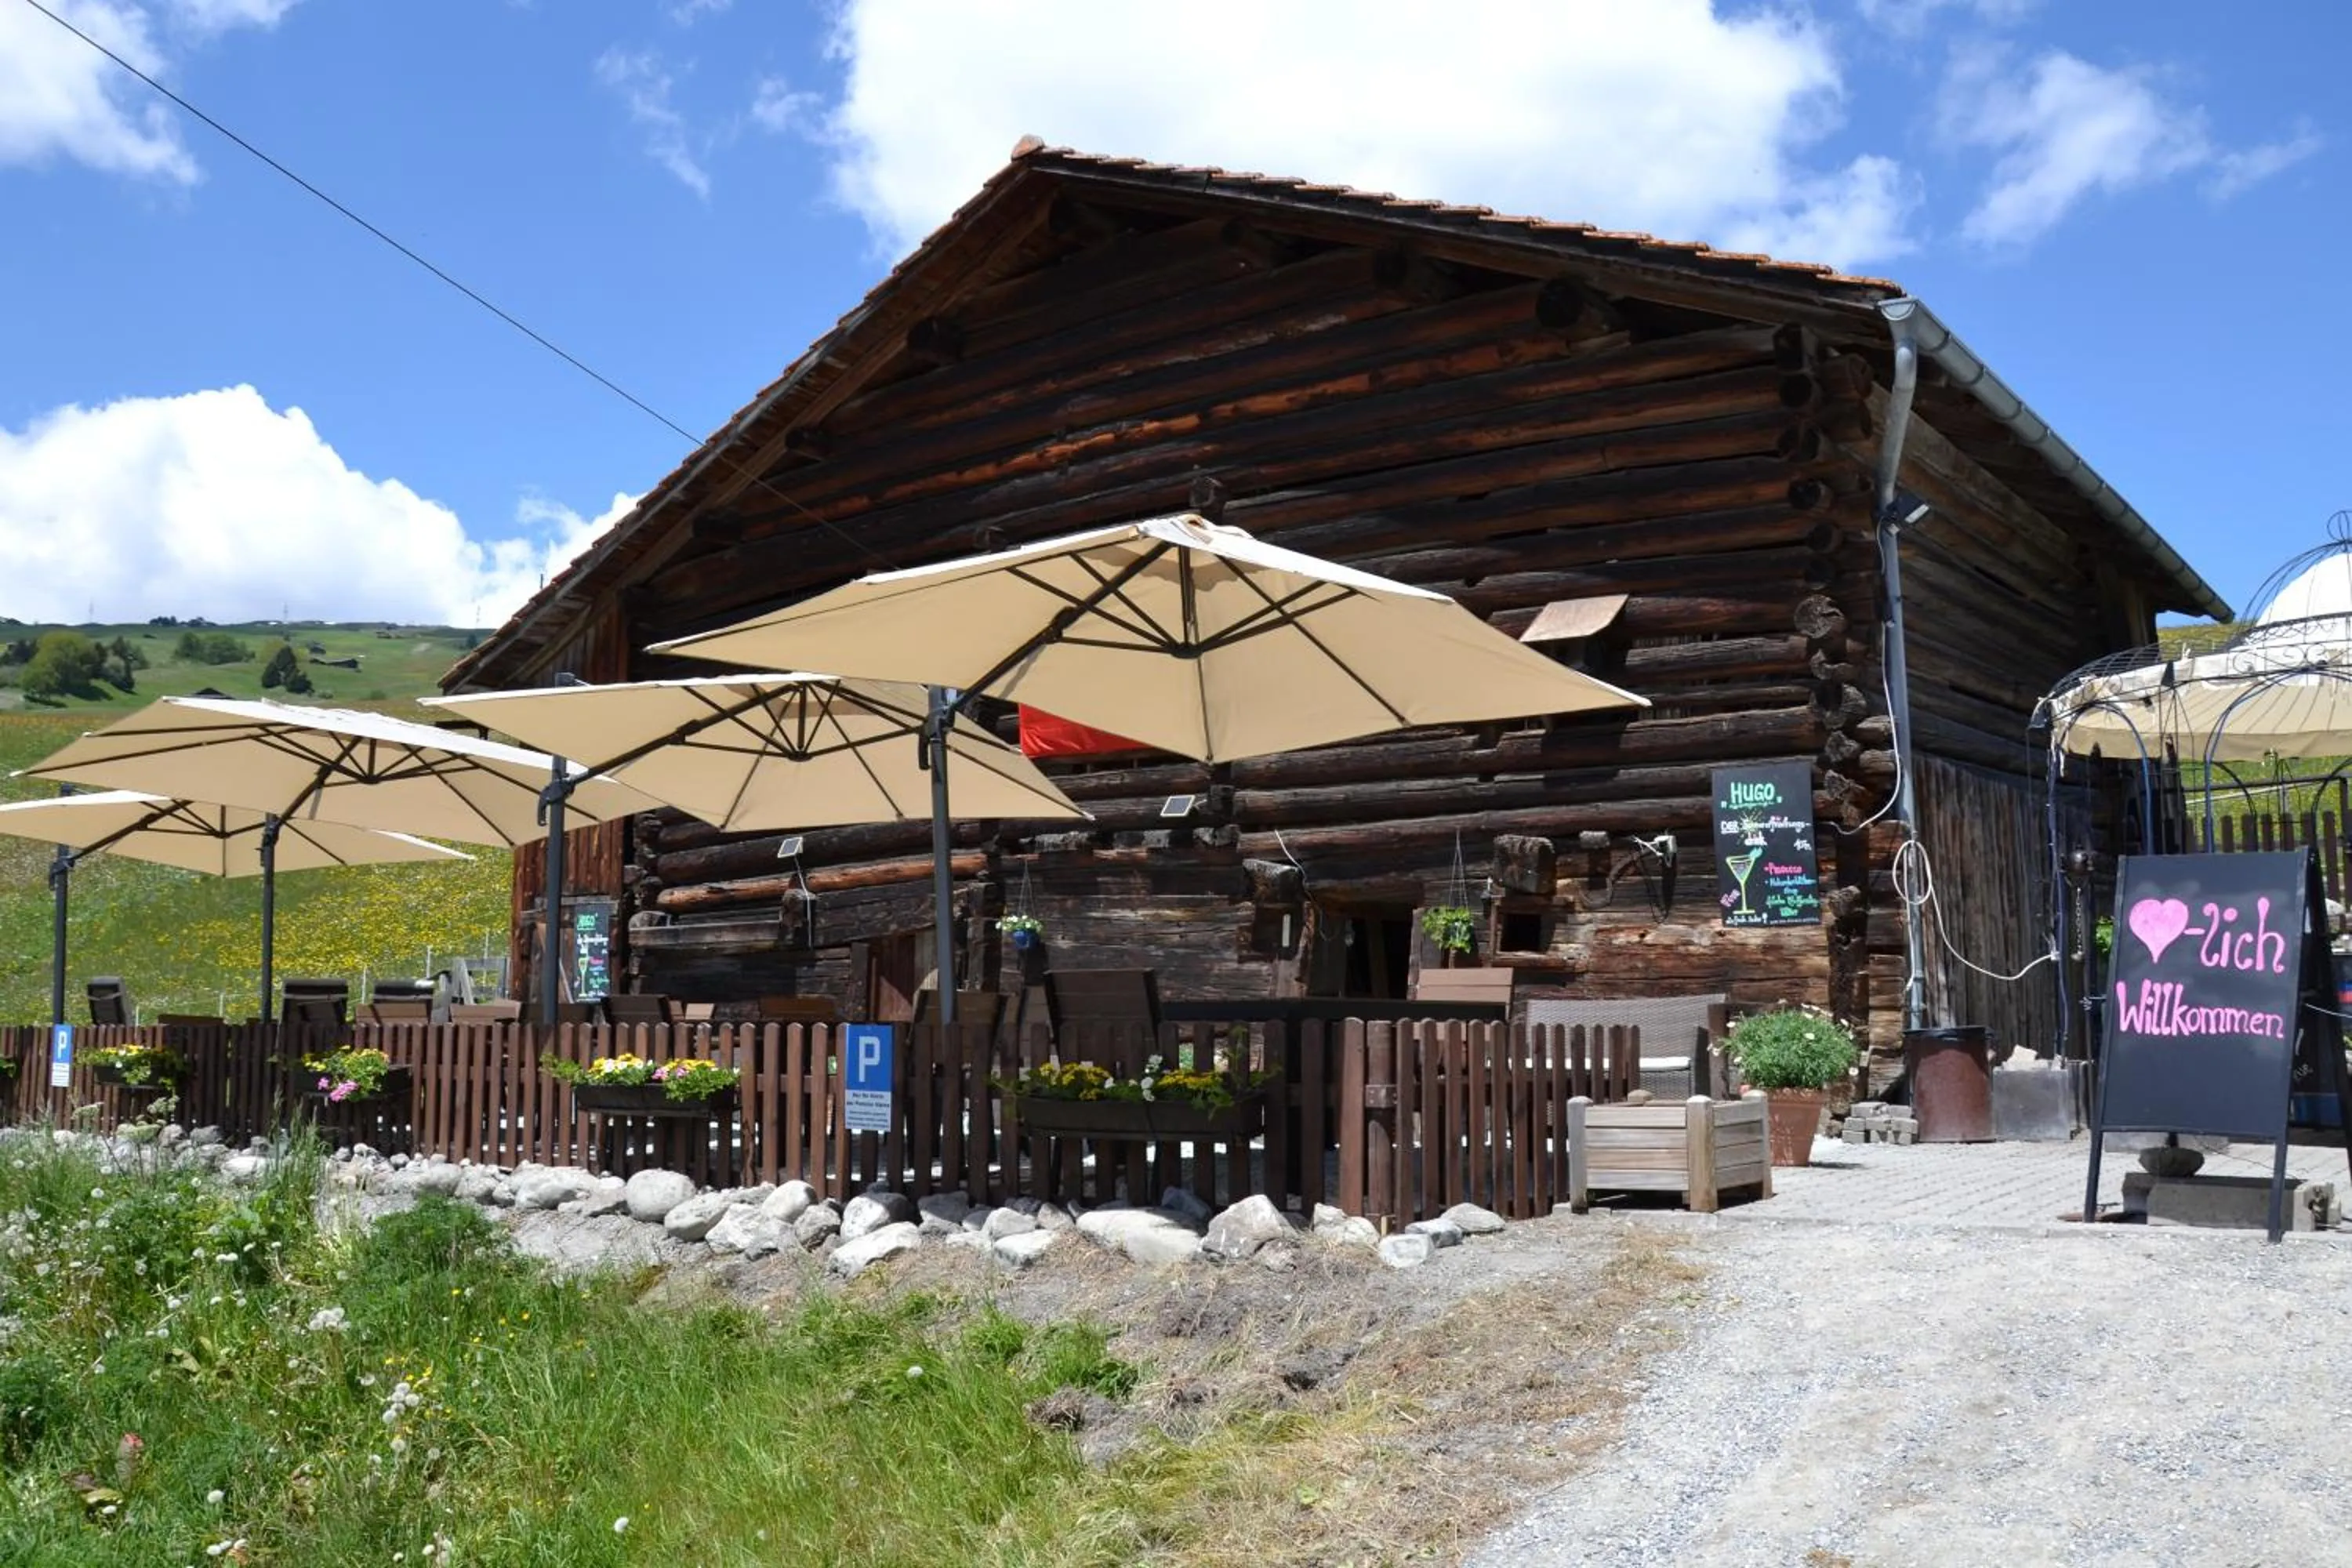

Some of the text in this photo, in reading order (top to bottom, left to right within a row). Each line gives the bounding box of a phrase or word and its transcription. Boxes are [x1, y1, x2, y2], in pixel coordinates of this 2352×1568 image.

[2116, 979, 2284, 1039] Willkommen
[57, 1031, 67, 1059] P
[858, 1036, 880, 1083] P
